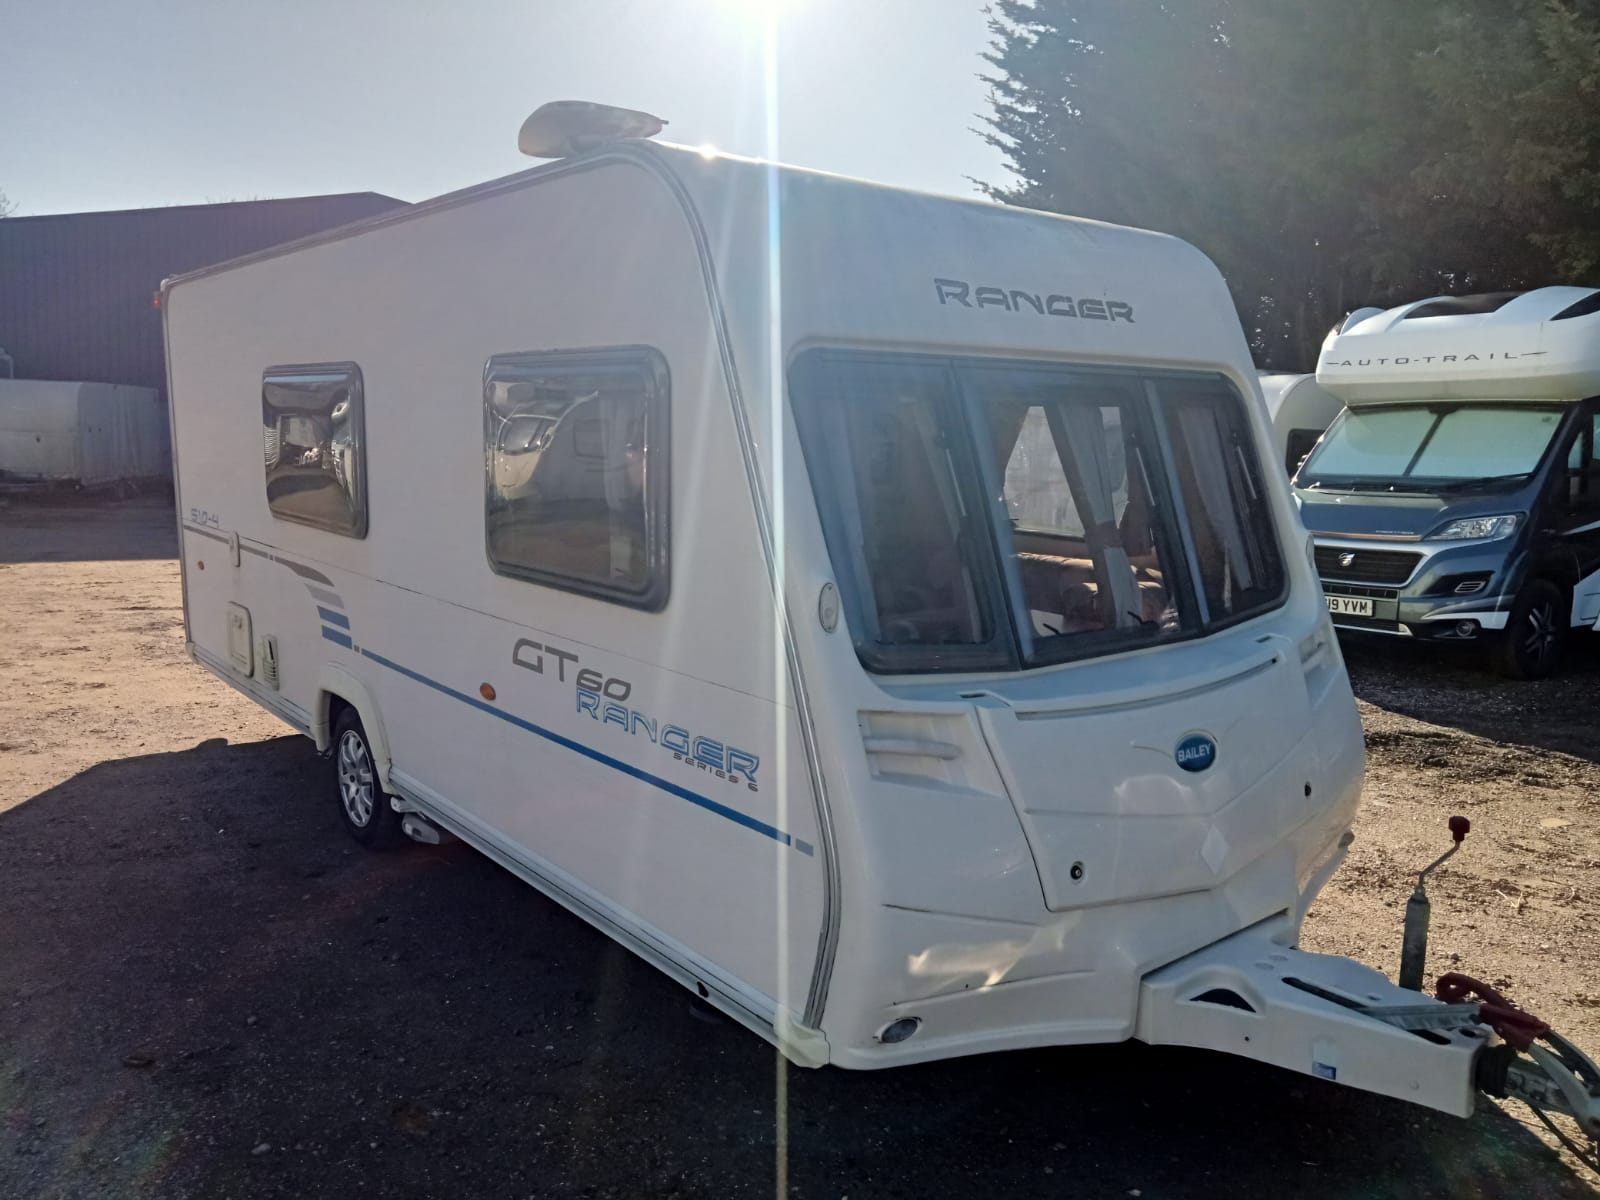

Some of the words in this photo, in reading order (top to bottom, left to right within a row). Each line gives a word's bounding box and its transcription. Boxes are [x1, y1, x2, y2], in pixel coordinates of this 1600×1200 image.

[933, 277, 1136, 324] RANGER
[1340, 352, 1518, 367] AUTO-TRAIL
[1342, 599, 1368, 614] YVM
[576, 687, 760, 783] RANGER
[1177, 742, 1212, 763] BAILEY
[673, 752, 739, 784] SERIES
